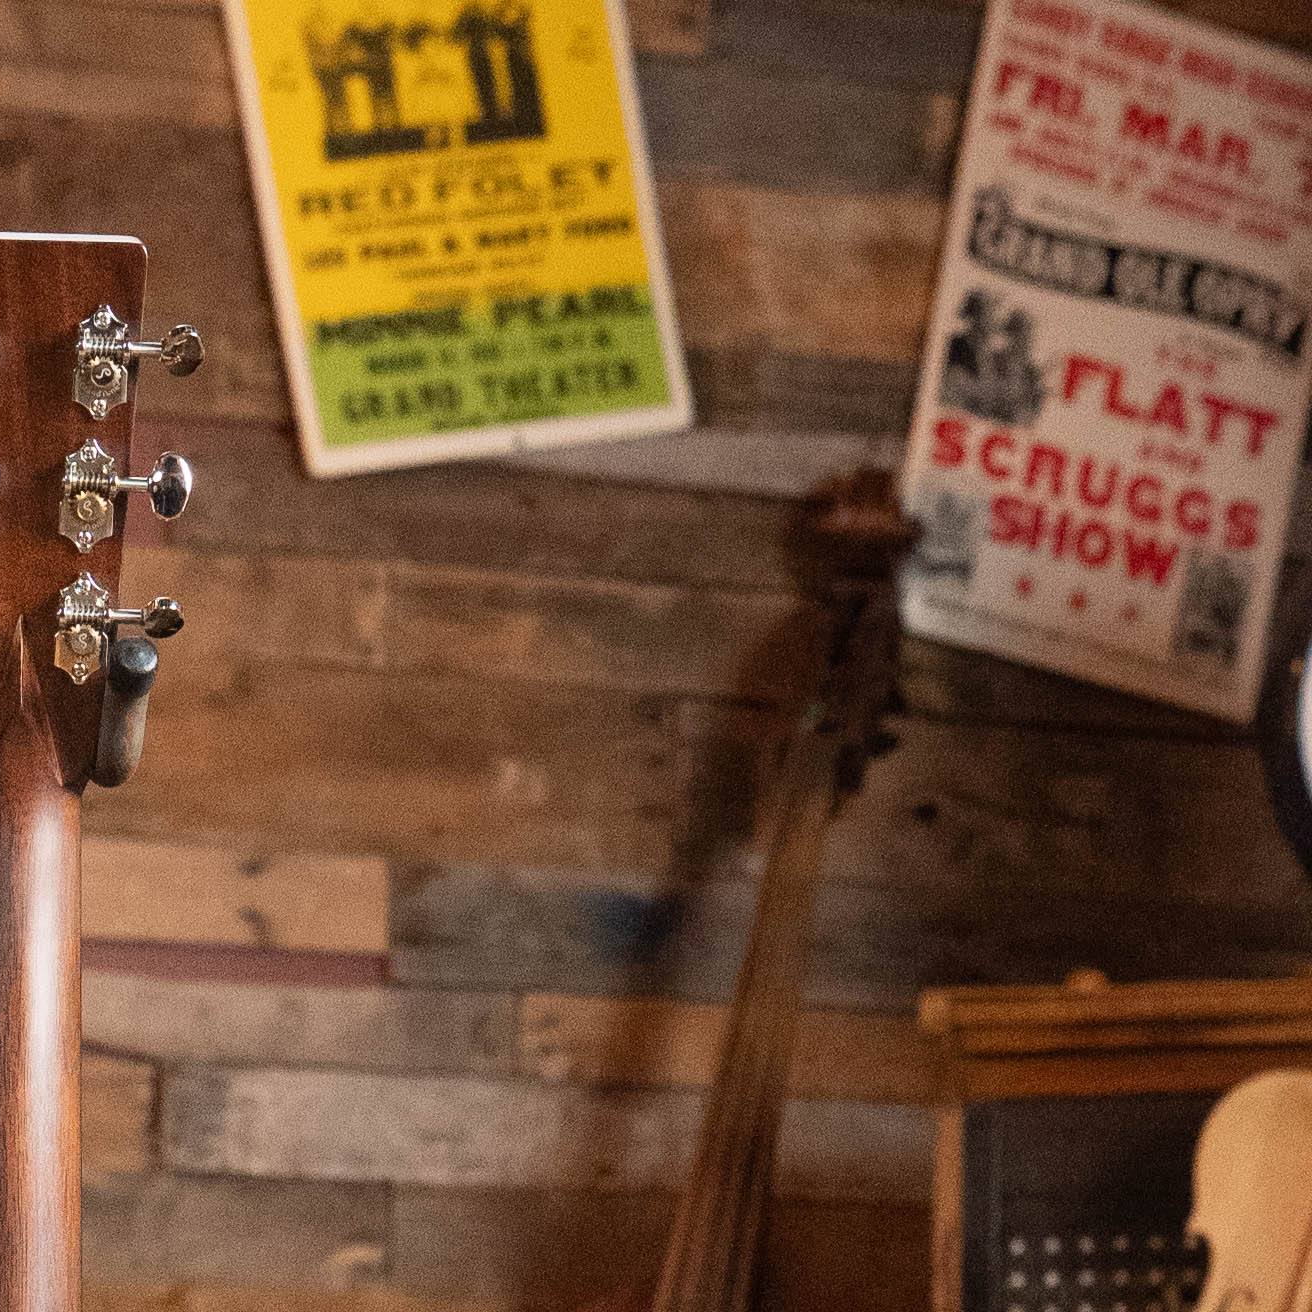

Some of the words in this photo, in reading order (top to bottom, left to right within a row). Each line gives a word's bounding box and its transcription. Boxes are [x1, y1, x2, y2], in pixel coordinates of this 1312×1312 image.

[1062, 353, 1283, 457] FLATT
[931, 416, 1261, 550] SCRUGGS
[989, 495, 1179, 586] SHOW
